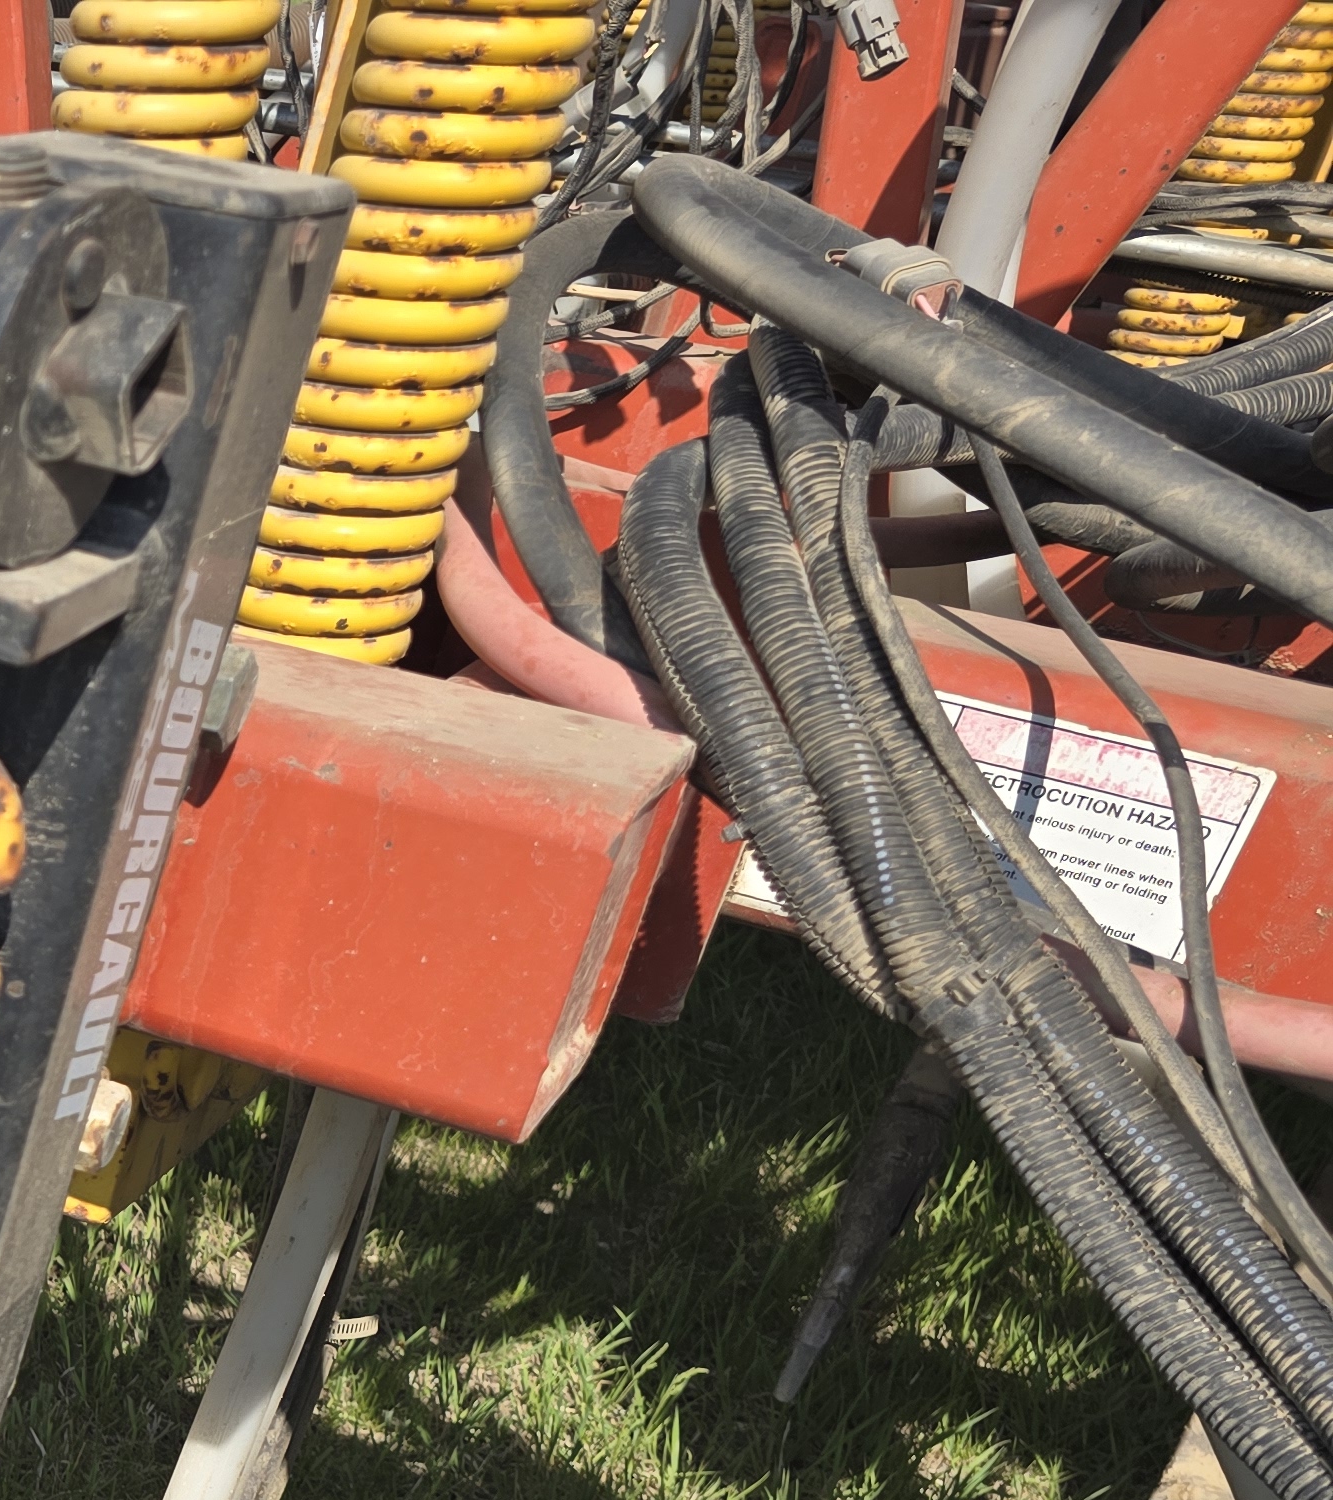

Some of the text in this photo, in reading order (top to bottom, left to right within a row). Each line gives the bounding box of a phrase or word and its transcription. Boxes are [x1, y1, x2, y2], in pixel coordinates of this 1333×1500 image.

[1027, 814, 1074, 834] serious
[1078, 823, 1115, 845] injury
[1118, 834, 1132, 846] or
[1135, 837, 1176, 858] death:
[54, 618, 224, 1121] BOURGAULT
[1060, 854, 1174, 889] power lines when
[1104, 878, 1168, 905] or folding
